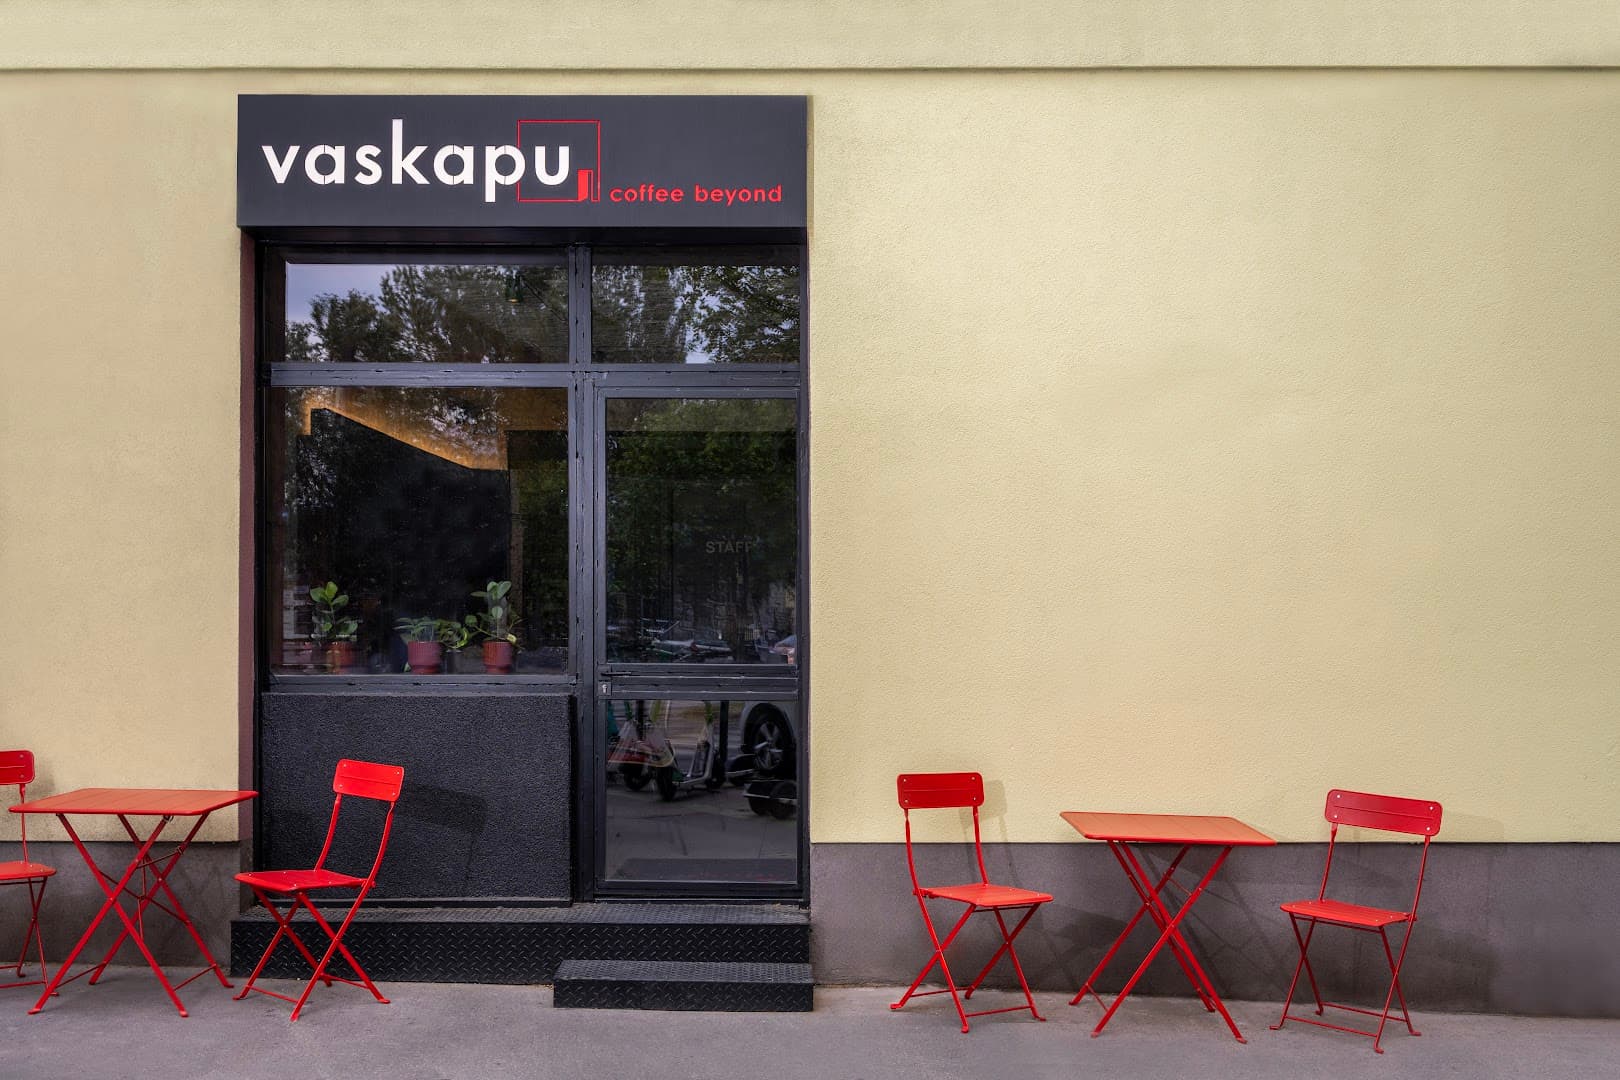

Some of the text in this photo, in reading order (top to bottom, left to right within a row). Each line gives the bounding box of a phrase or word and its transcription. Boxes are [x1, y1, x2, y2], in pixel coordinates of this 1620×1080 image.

[261, 118, 571, 203] vaskapu
[609, 183, 783, 206] coffee beyond
[705, 540, 753, 554] STAFF
